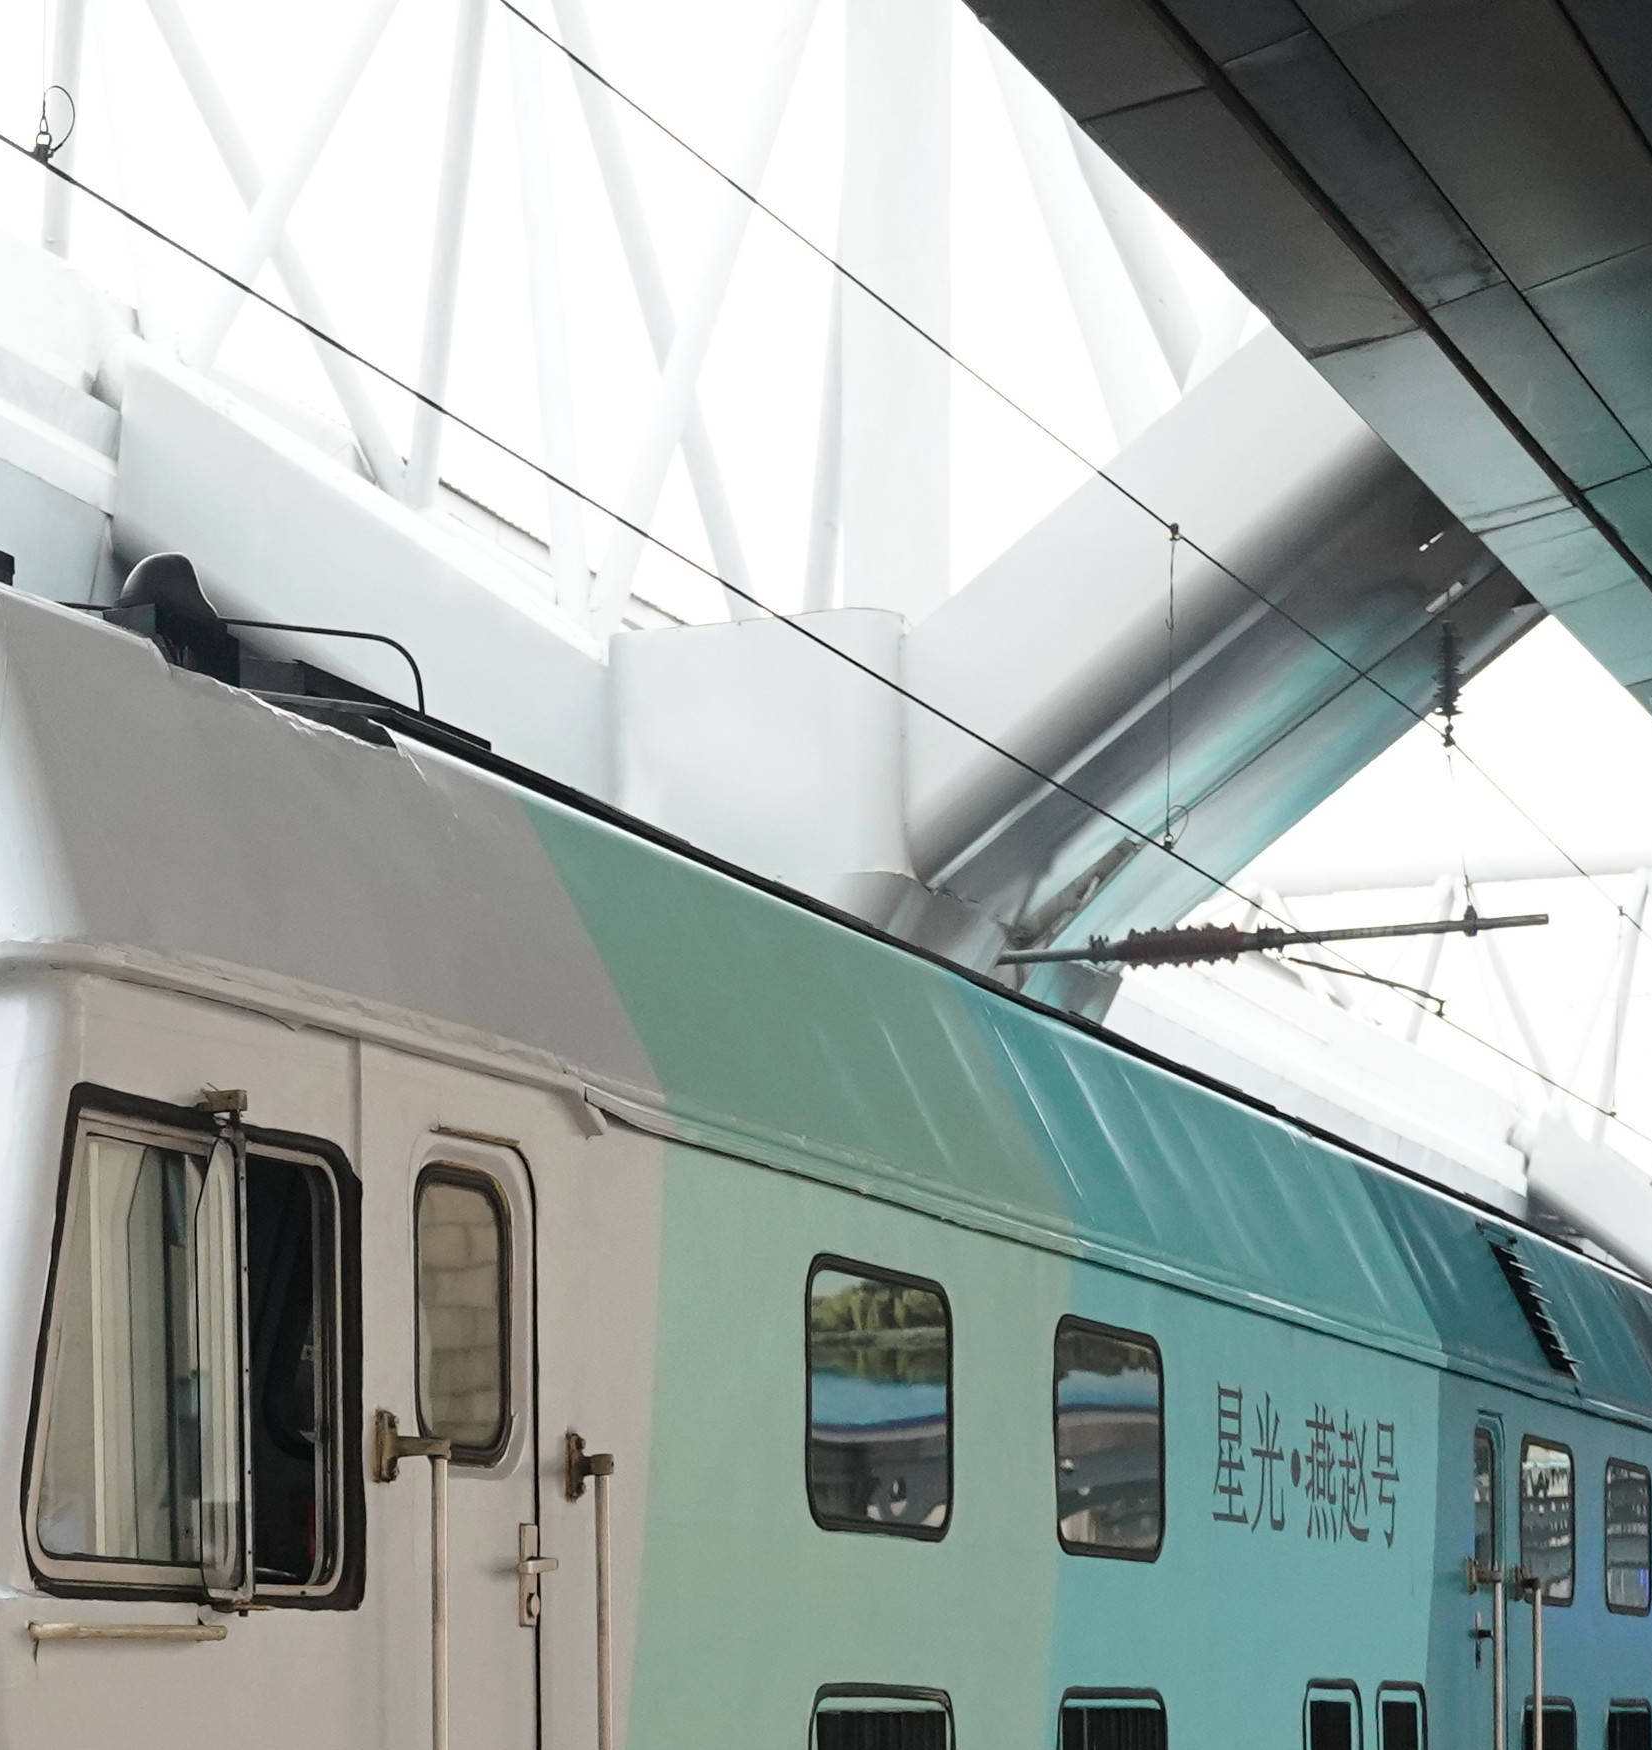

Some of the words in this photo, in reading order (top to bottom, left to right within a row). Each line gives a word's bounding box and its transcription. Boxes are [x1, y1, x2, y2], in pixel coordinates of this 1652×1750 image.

[1212, 1381, 1400, 1549] 星光·燕赵号
